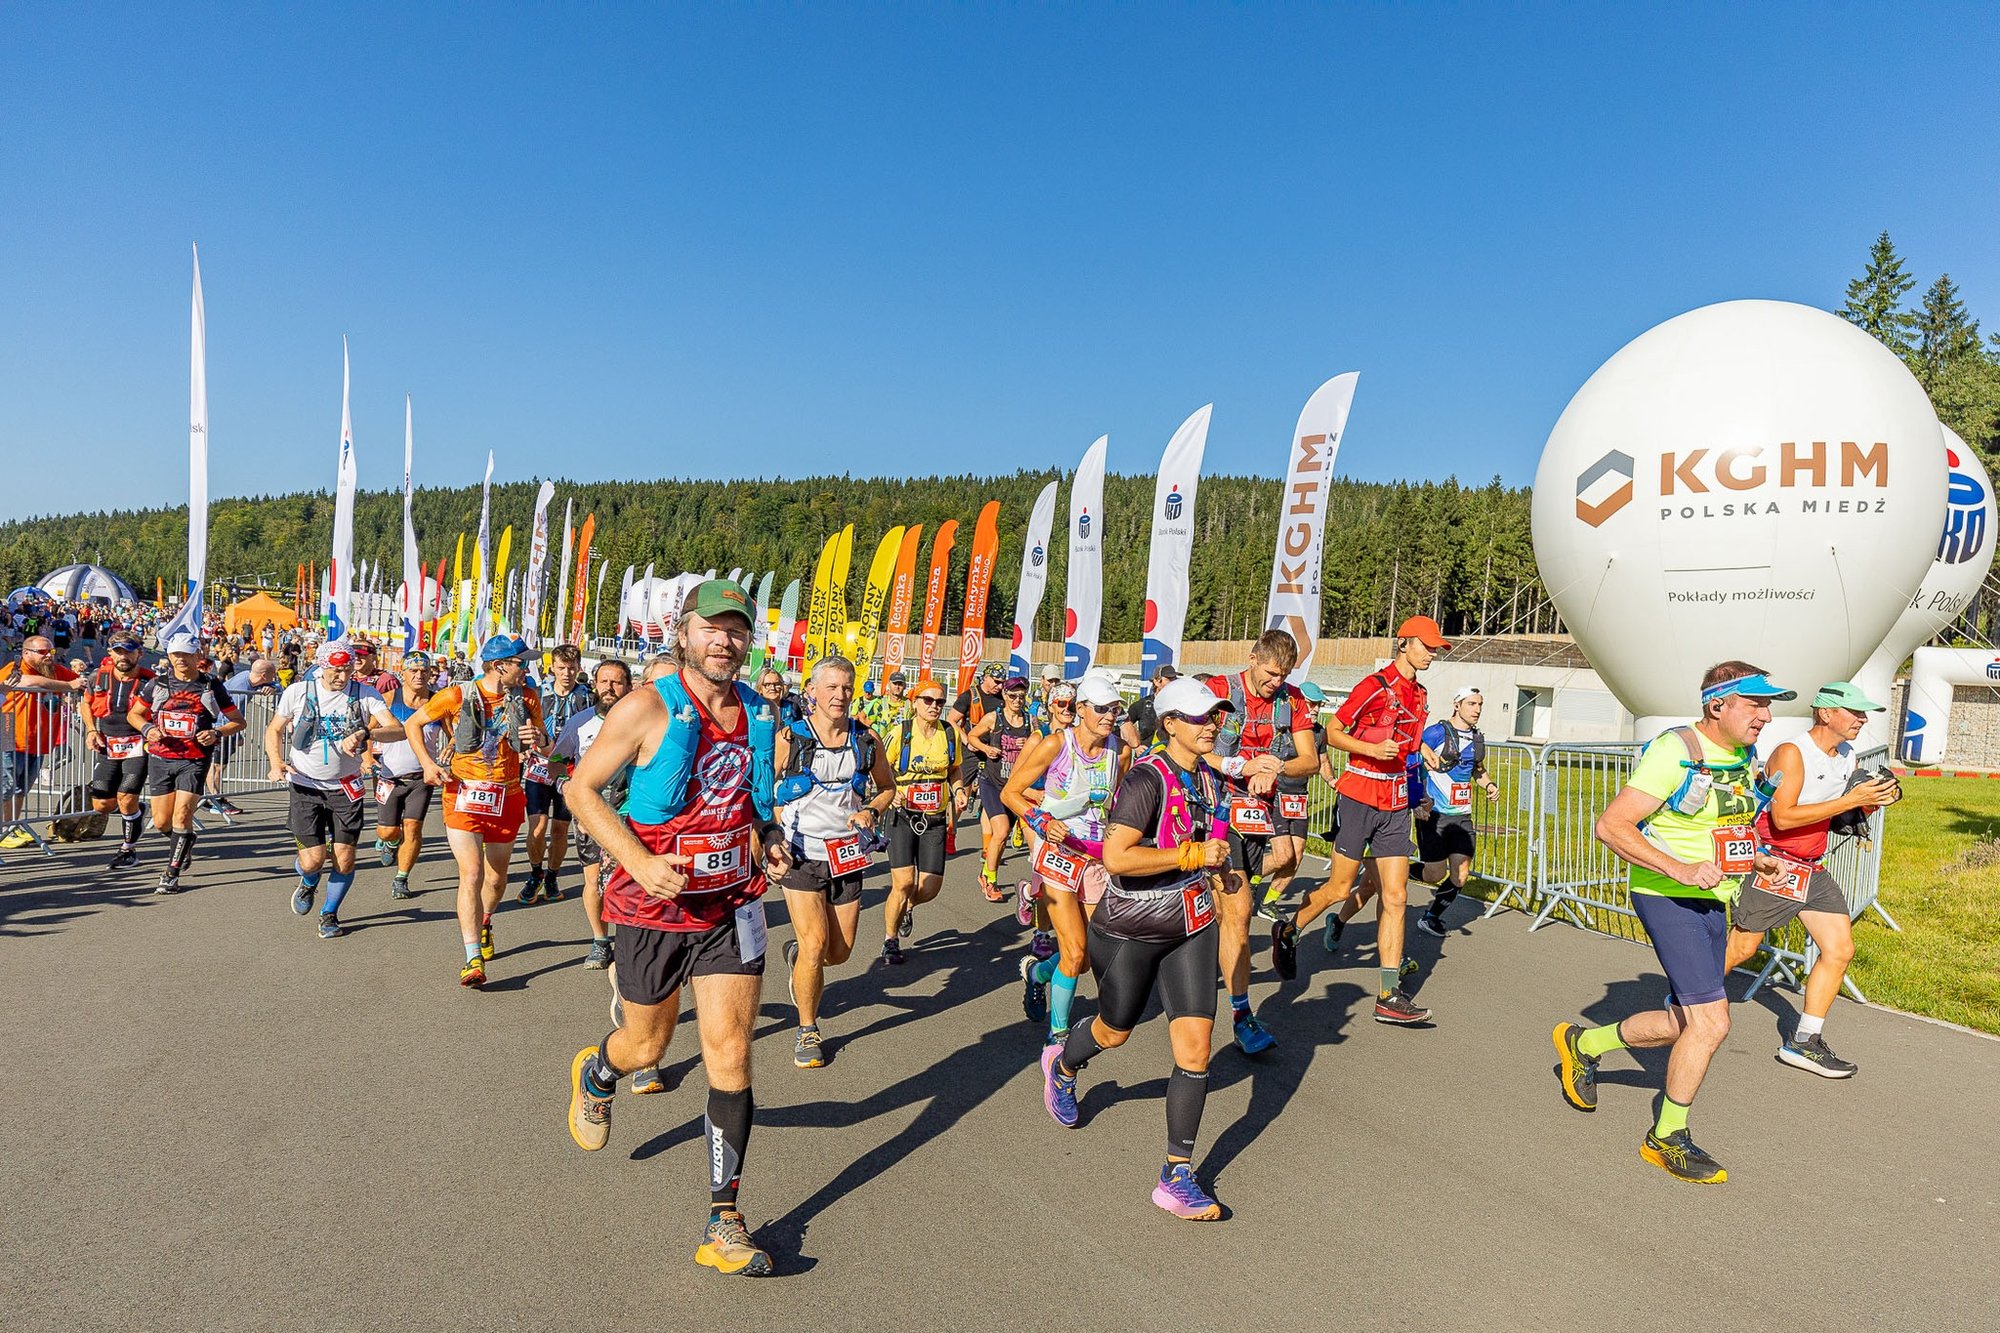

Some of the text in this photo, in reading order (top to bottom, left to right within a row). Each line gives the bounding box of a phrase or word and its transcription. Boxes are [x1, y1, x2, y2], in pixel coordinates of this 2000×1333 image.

[1661, 442, 1888, 496] KGHM
[1277, 434, 1327, 594] KGHM
[1661, 501, 1781, 520] POLSKA
[976, 558, 991, 618] POLSKIE RADIO
[1668, 588, 1816, 604] Pokłady możliwości
[829, 581, 839, 633] DOLNY
[859, 581, 877, 637] DOLNY
[890, 573, 906, 628] Jedynka
[809, 586, 821, 635] DOLNY
[168, 720, 183, 729] 31
[533, 765, 548, 775] 184
[470, 791, 494, 803] 181
[915, 792, 936, 801] 206
[1458, 789, 1469, 798] 44
[1243, 809, 1261, 820] 43
[1728, 841, 1753, 856] 232
[707, 850, 732, 869] 89
[1045, 853, 1073, 872] 252
[711, 1124, 724, 1185] BOOSTER
